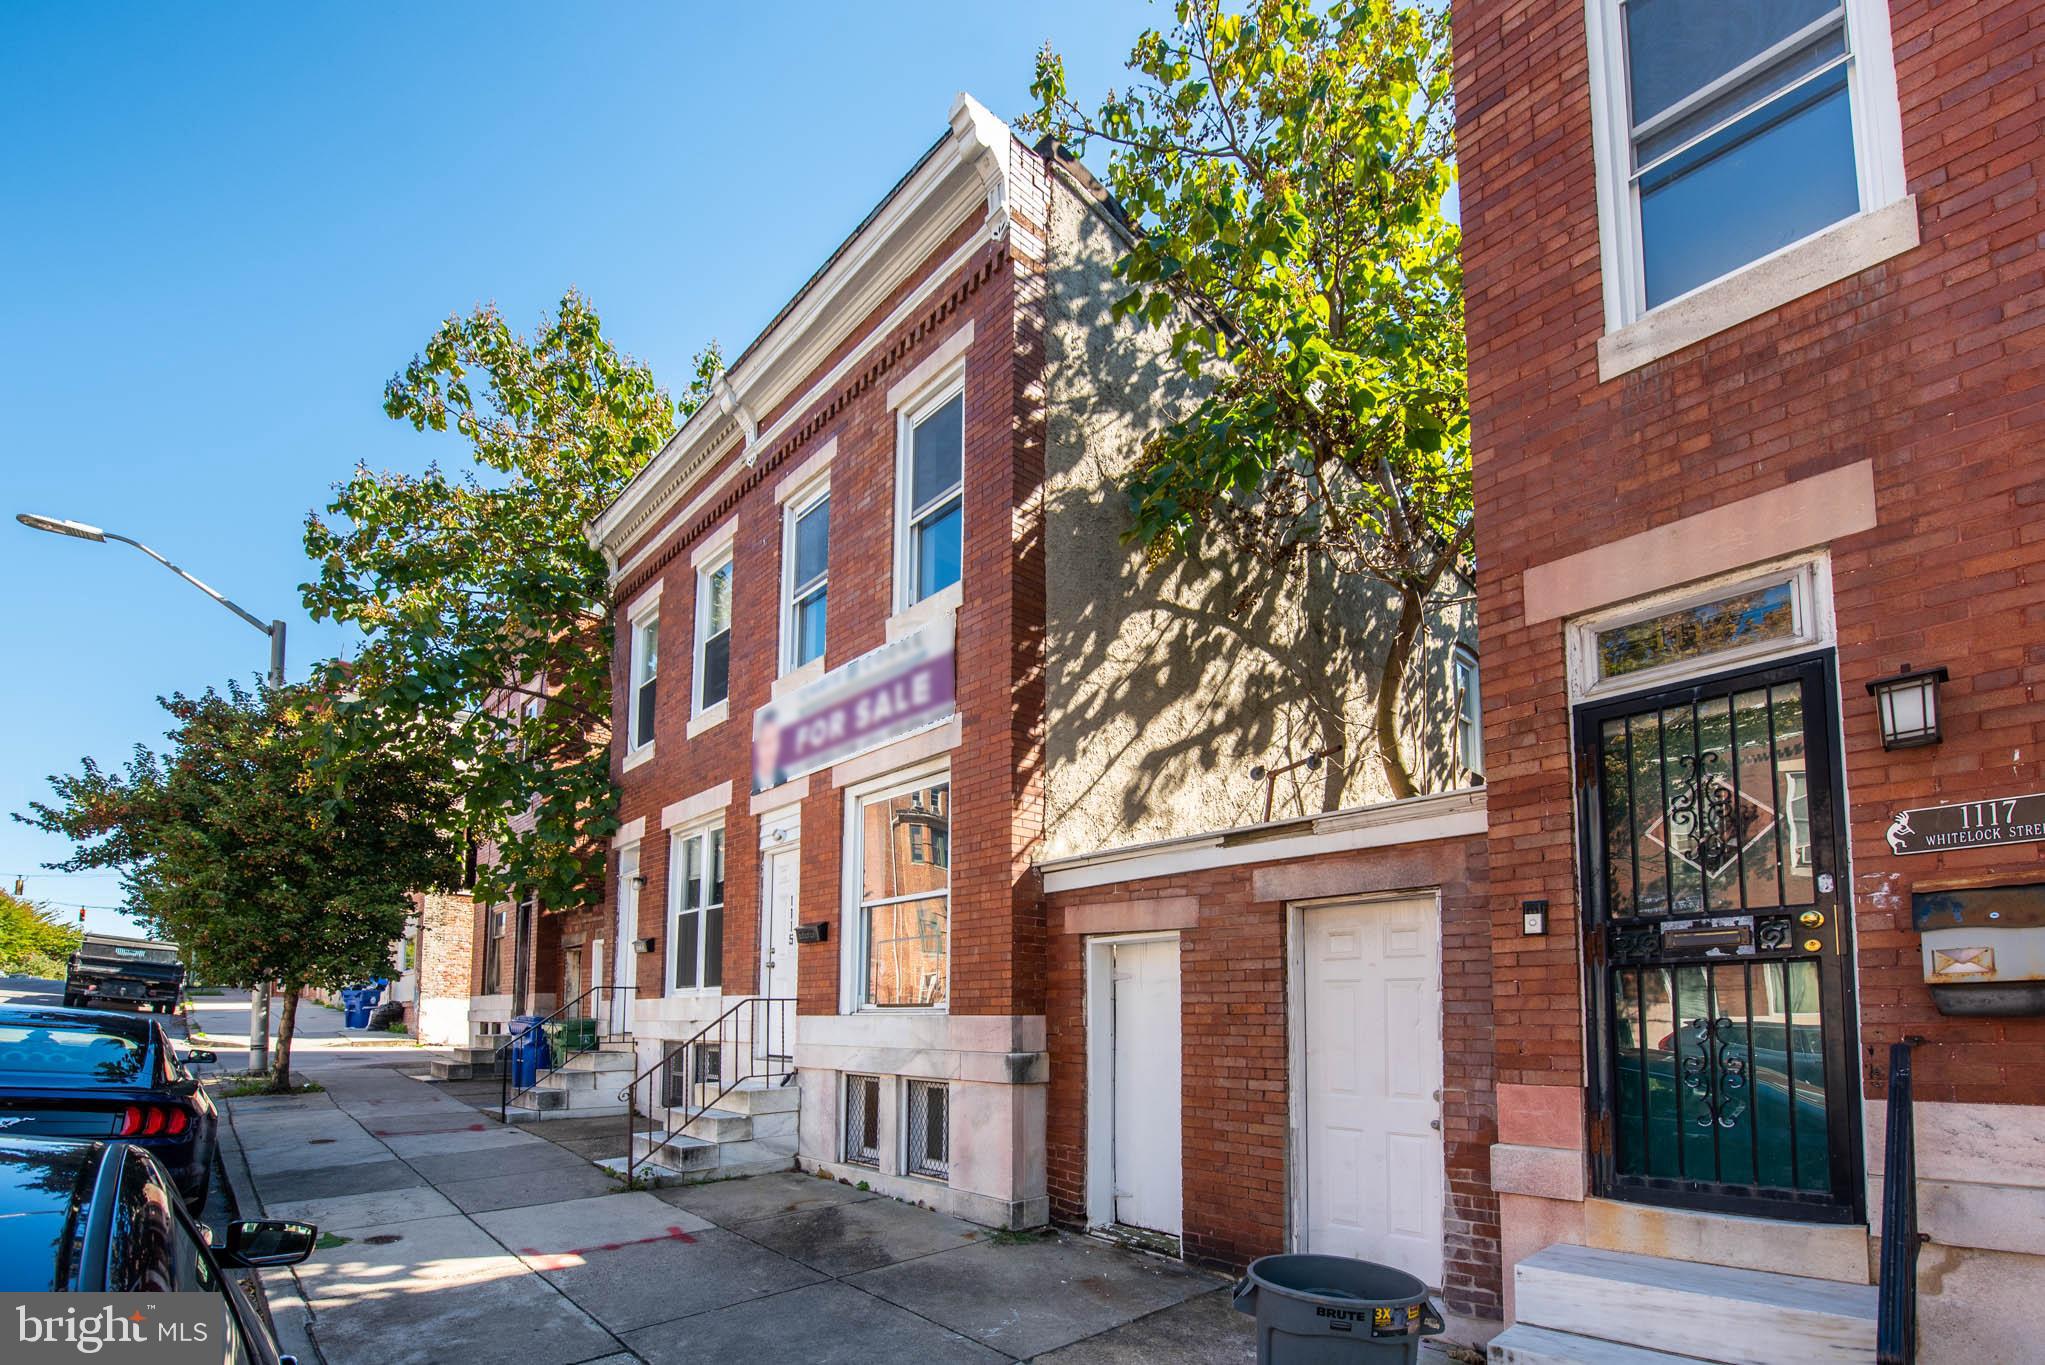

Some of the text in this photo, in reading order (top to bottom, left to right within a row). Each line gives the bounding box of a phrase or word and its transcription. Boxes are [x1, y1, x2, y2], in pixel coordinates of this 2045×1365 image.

[796, 710, 846, 754] FOR
[855, 671, 931, 730] SALE
[1960, 800, 2016, 828] 1117
[1925, 827, 2001, 846] WHITELOCK
[1316, 1306, 1365, 1321] BRUTE
